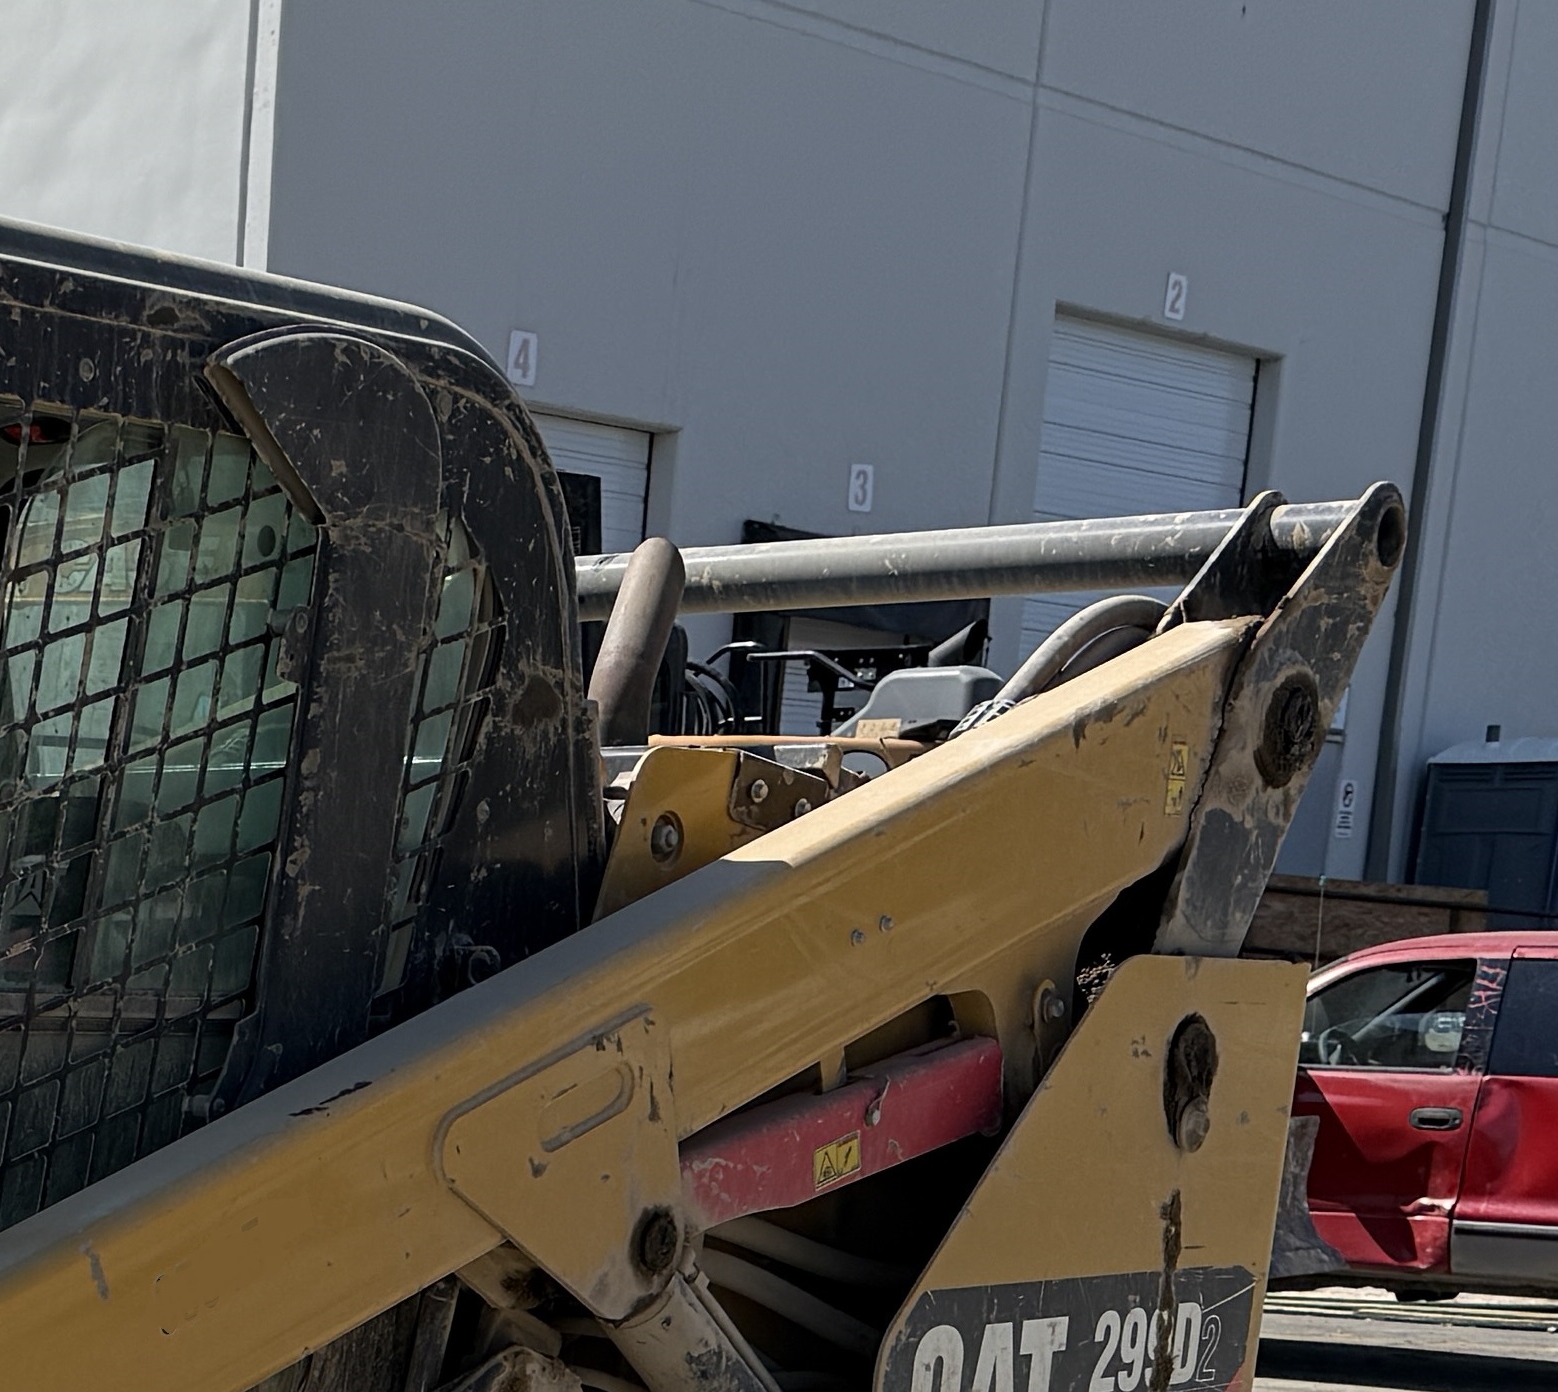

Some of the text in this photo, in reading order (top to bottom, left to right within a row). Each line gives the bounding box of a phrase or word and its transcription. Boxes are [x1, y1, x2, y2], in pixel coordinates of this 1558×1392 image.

[1169, 279, 1183, 315] 2
[513, 338, 531, 379] 4
[854, 469, 868, 506] 3
